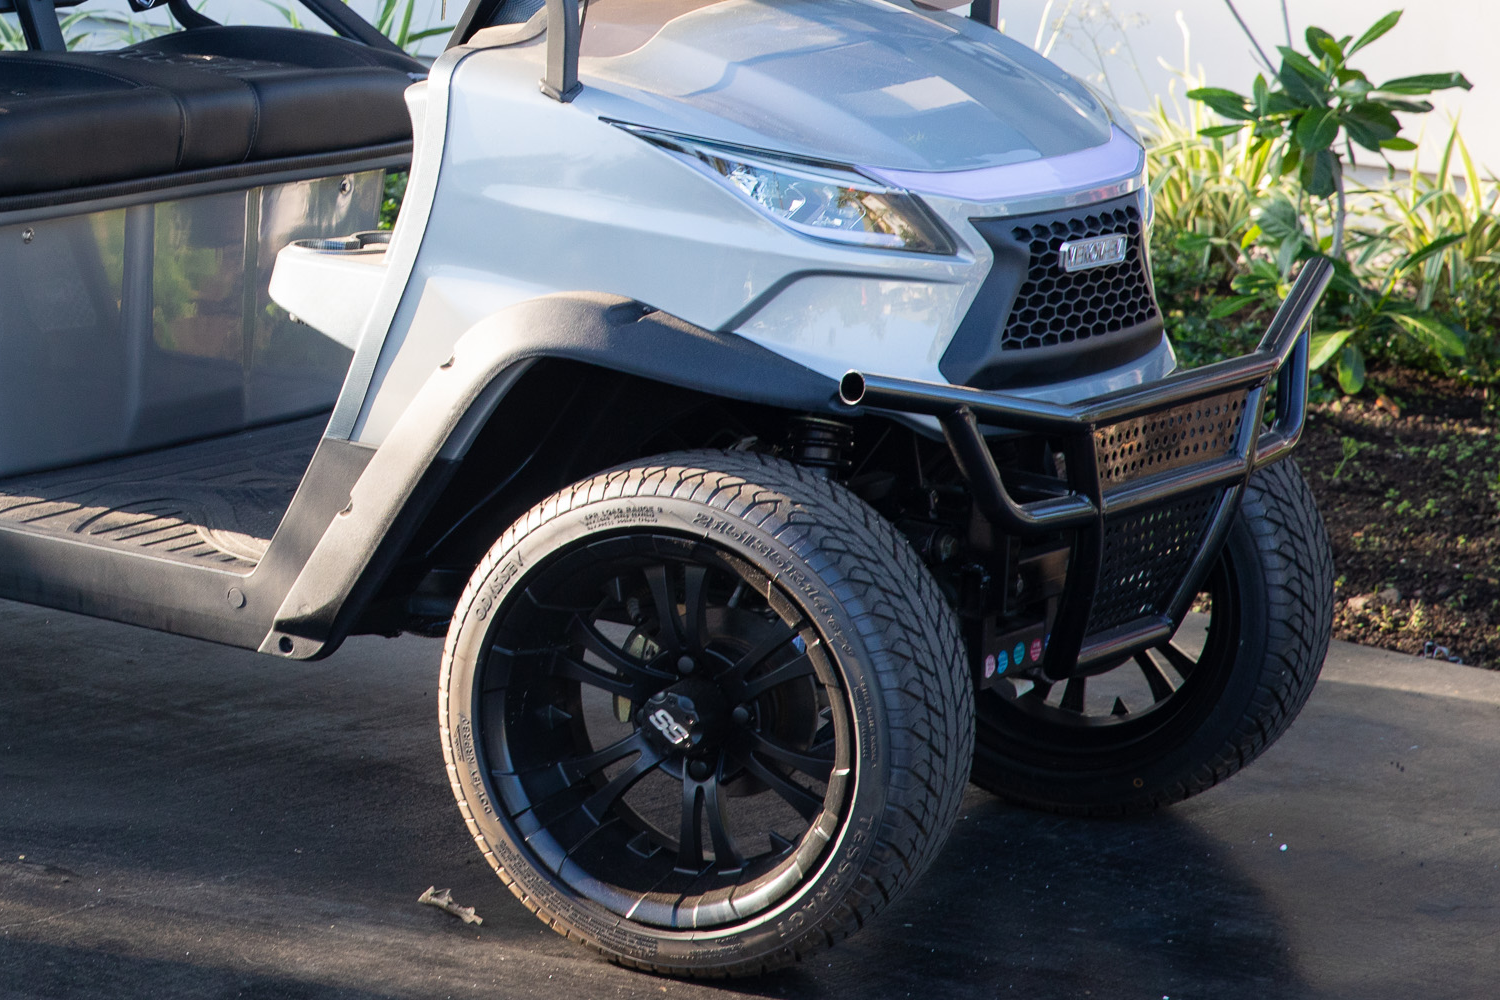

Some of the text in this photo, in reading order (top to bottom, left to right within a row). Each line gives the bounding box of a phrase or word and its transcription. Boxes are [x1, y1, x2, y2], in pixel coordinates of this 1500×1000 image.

[475, 550, 524, 621] ODYSSEY
[649, 708, 689, 745] SS
[777, 815, 874, 938] TESSERACT
